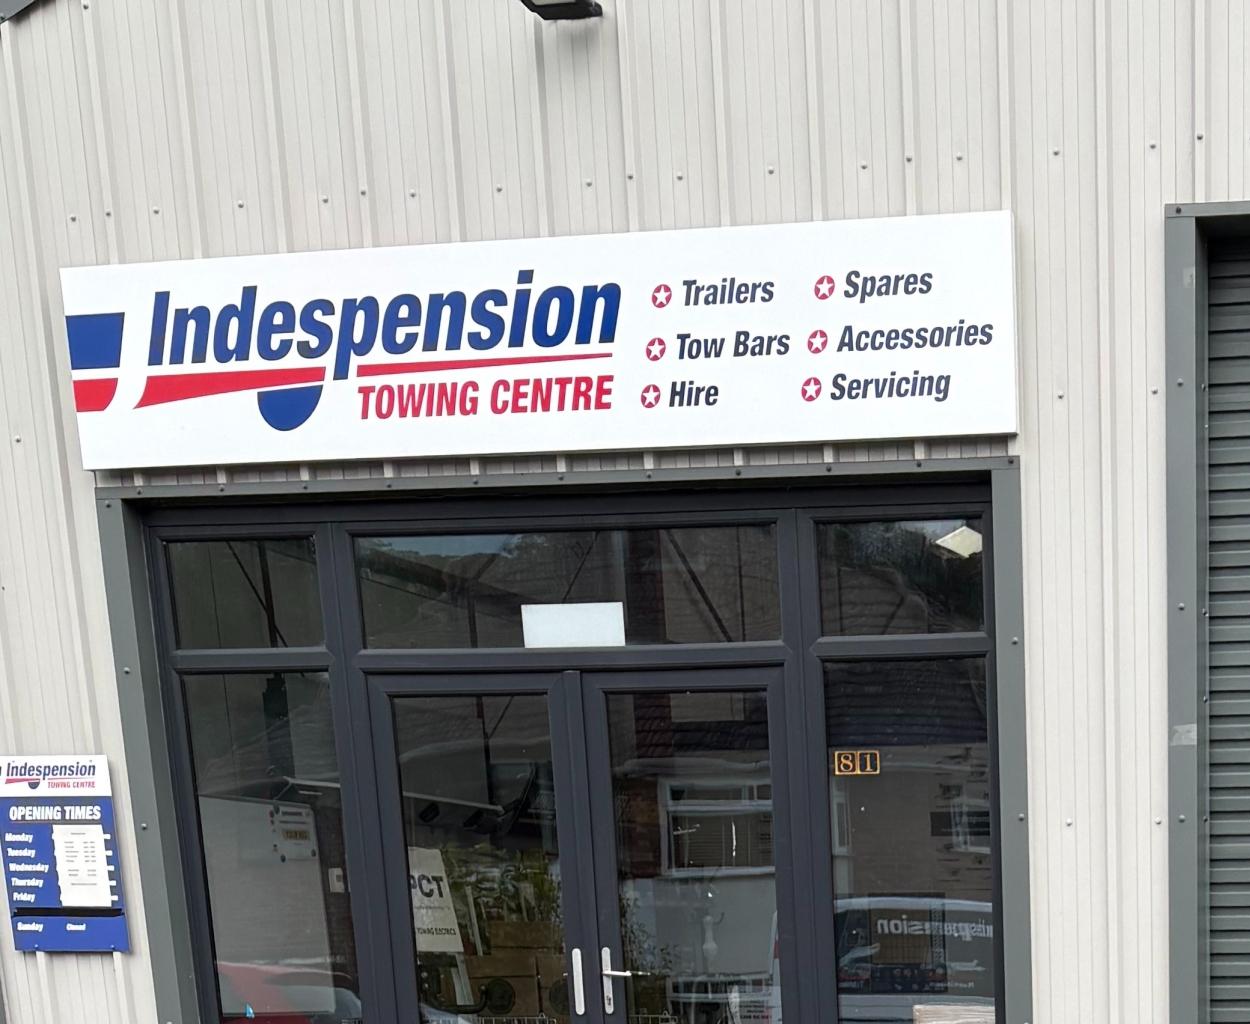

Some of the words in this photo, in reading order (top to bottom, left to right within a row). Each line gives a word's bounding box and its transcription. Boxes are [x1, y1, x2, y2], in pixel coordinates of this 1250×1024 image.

[682, 277, 775, 307] Trailers
[843, 270, 933, 304] Spares
[148, 270, 622, 381] Indespension
[836, 319, 994, 353] Accessories
[676, 332, 725, 360] Tow
[732, 330, 791, 358] Bars
[357, 381, 479, 420] TOWING
[490, 375, 614, 416] CENTRE
[668, 380, 719, 408] Hire
[830, 370, 951, 402] Servicing
[6, 761, 96, 780] Indespension
[840, 753, 874, 772] 81
[9, 805, 62, 821] OPENING
[63, 805, 101, 820] TIMES
[5, 833, 33, 843] Monday
[7, 848, 36, 858] Tuesday
[9, 863, 49, 873] Wednesday
[11, 878, 44, 887] Thursday
[13, 892, 35, 902] Friday
